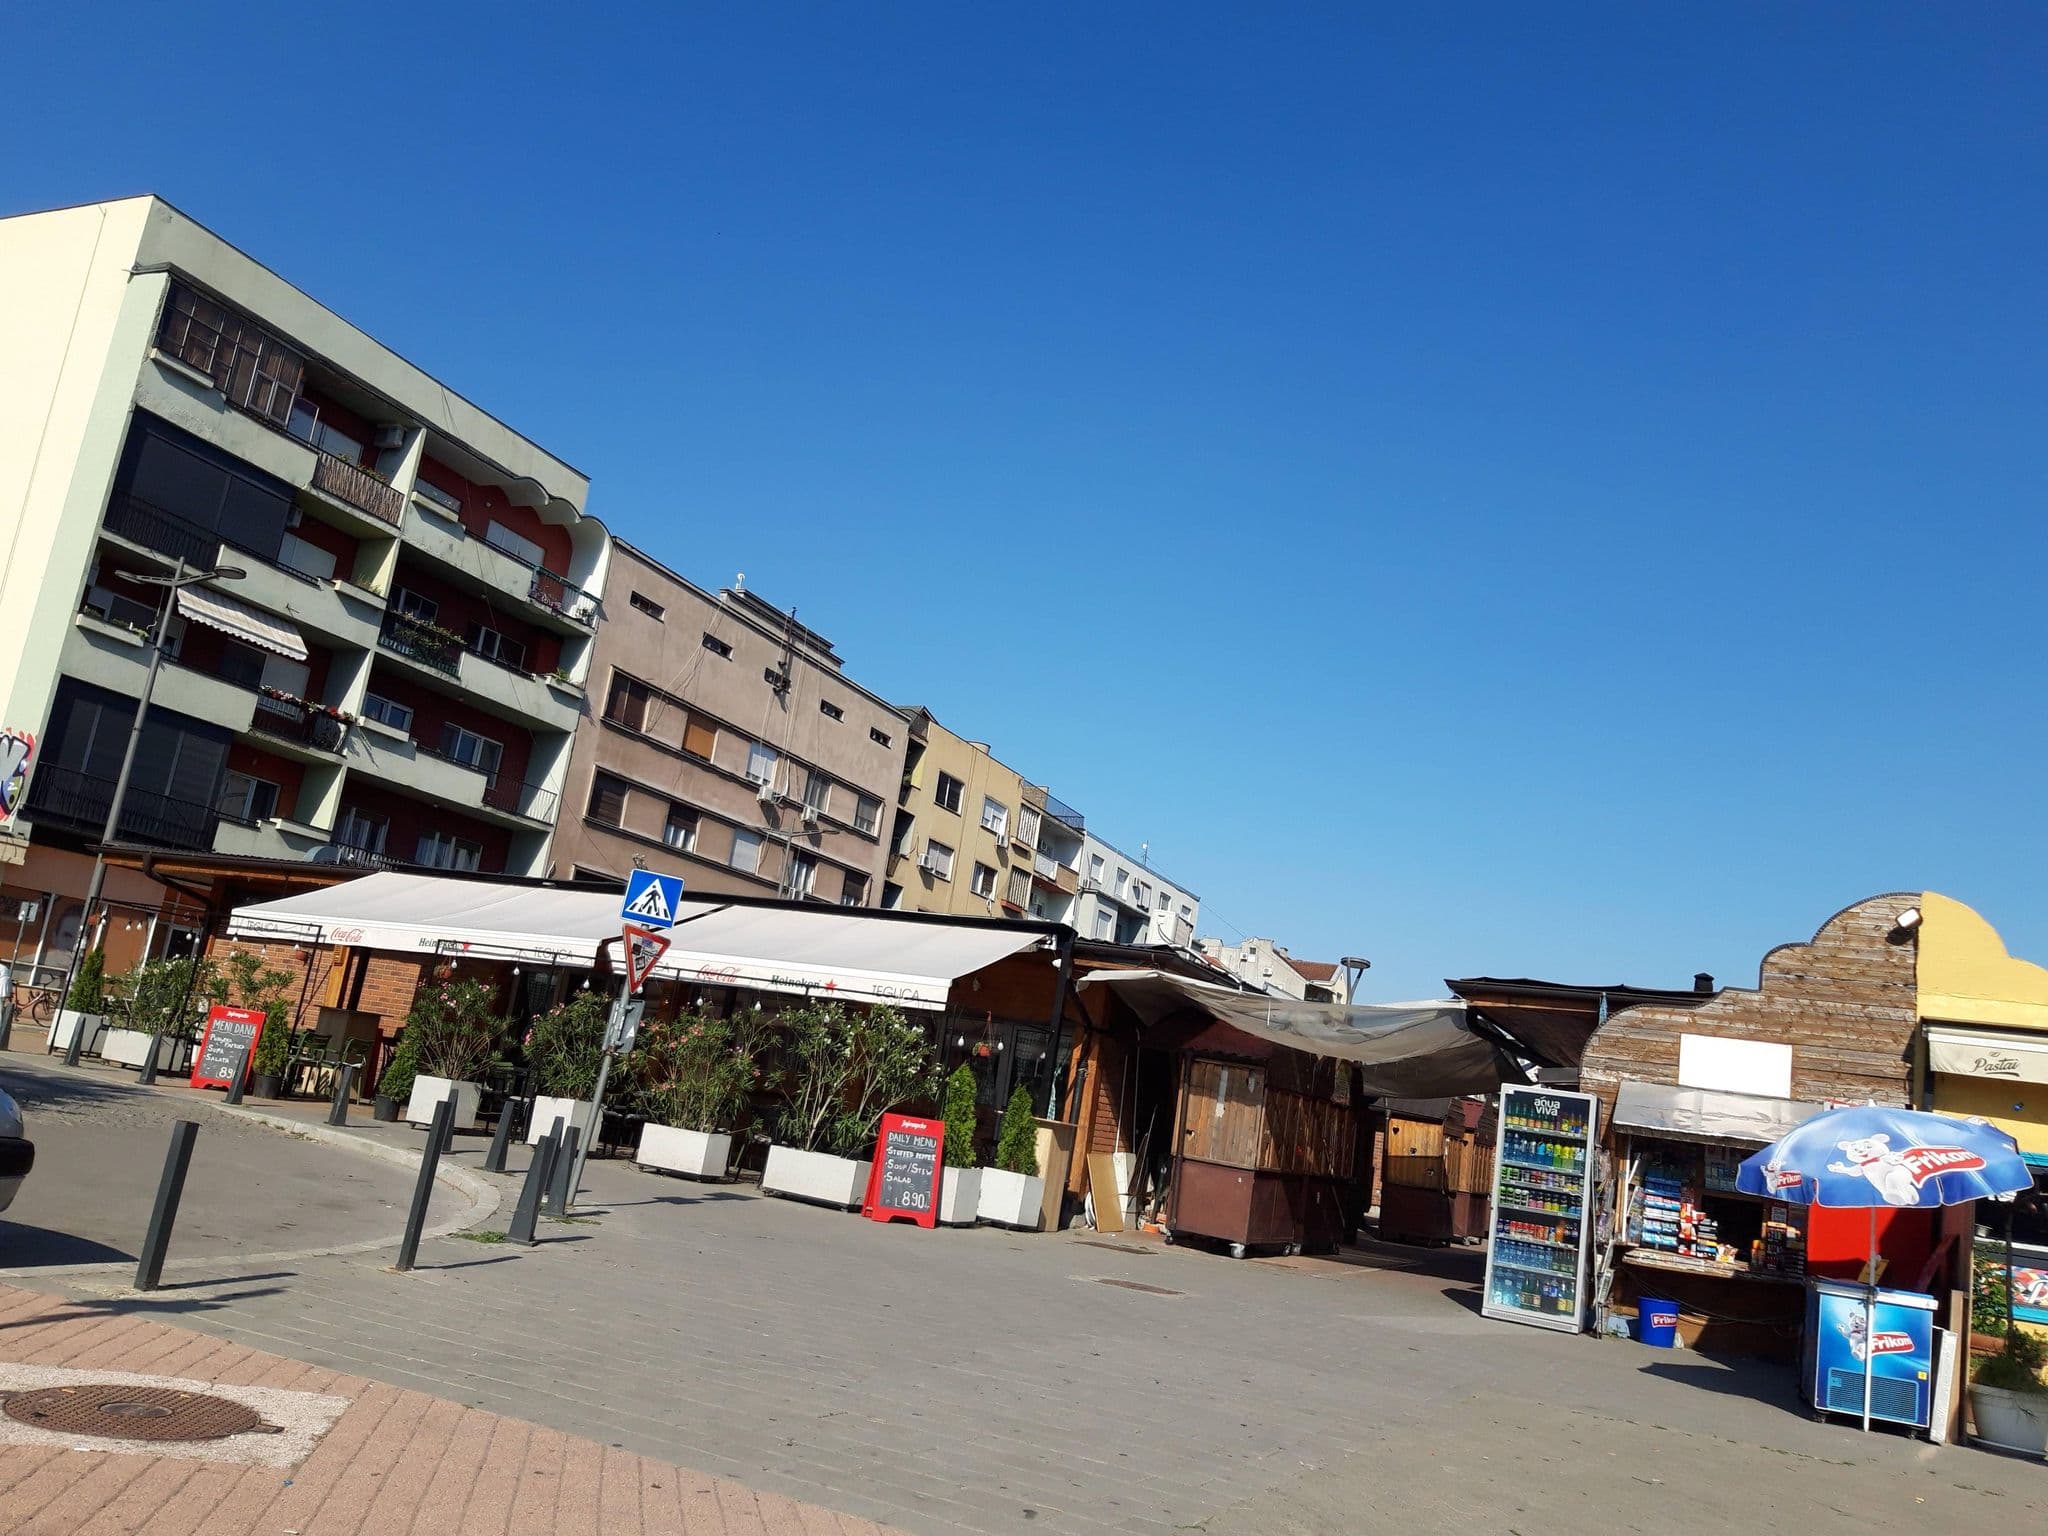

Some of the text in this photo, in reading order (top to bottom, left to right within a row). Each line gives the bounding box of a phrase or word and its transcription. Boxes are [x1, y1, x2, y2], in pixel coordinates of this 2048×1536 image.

[771, 974, 821, 989] Heineken
[212, 1020, 257, 1036] MENI DANA
[218, 1066, 236, 1079] 89
[1535, 1105, 1558, 1116] viva
[888, 1132, 937, 1148] DAILY MENU
[1908, 1149, 1978, 1176] Frikom
[902, 1191, 925, 1209] 890
